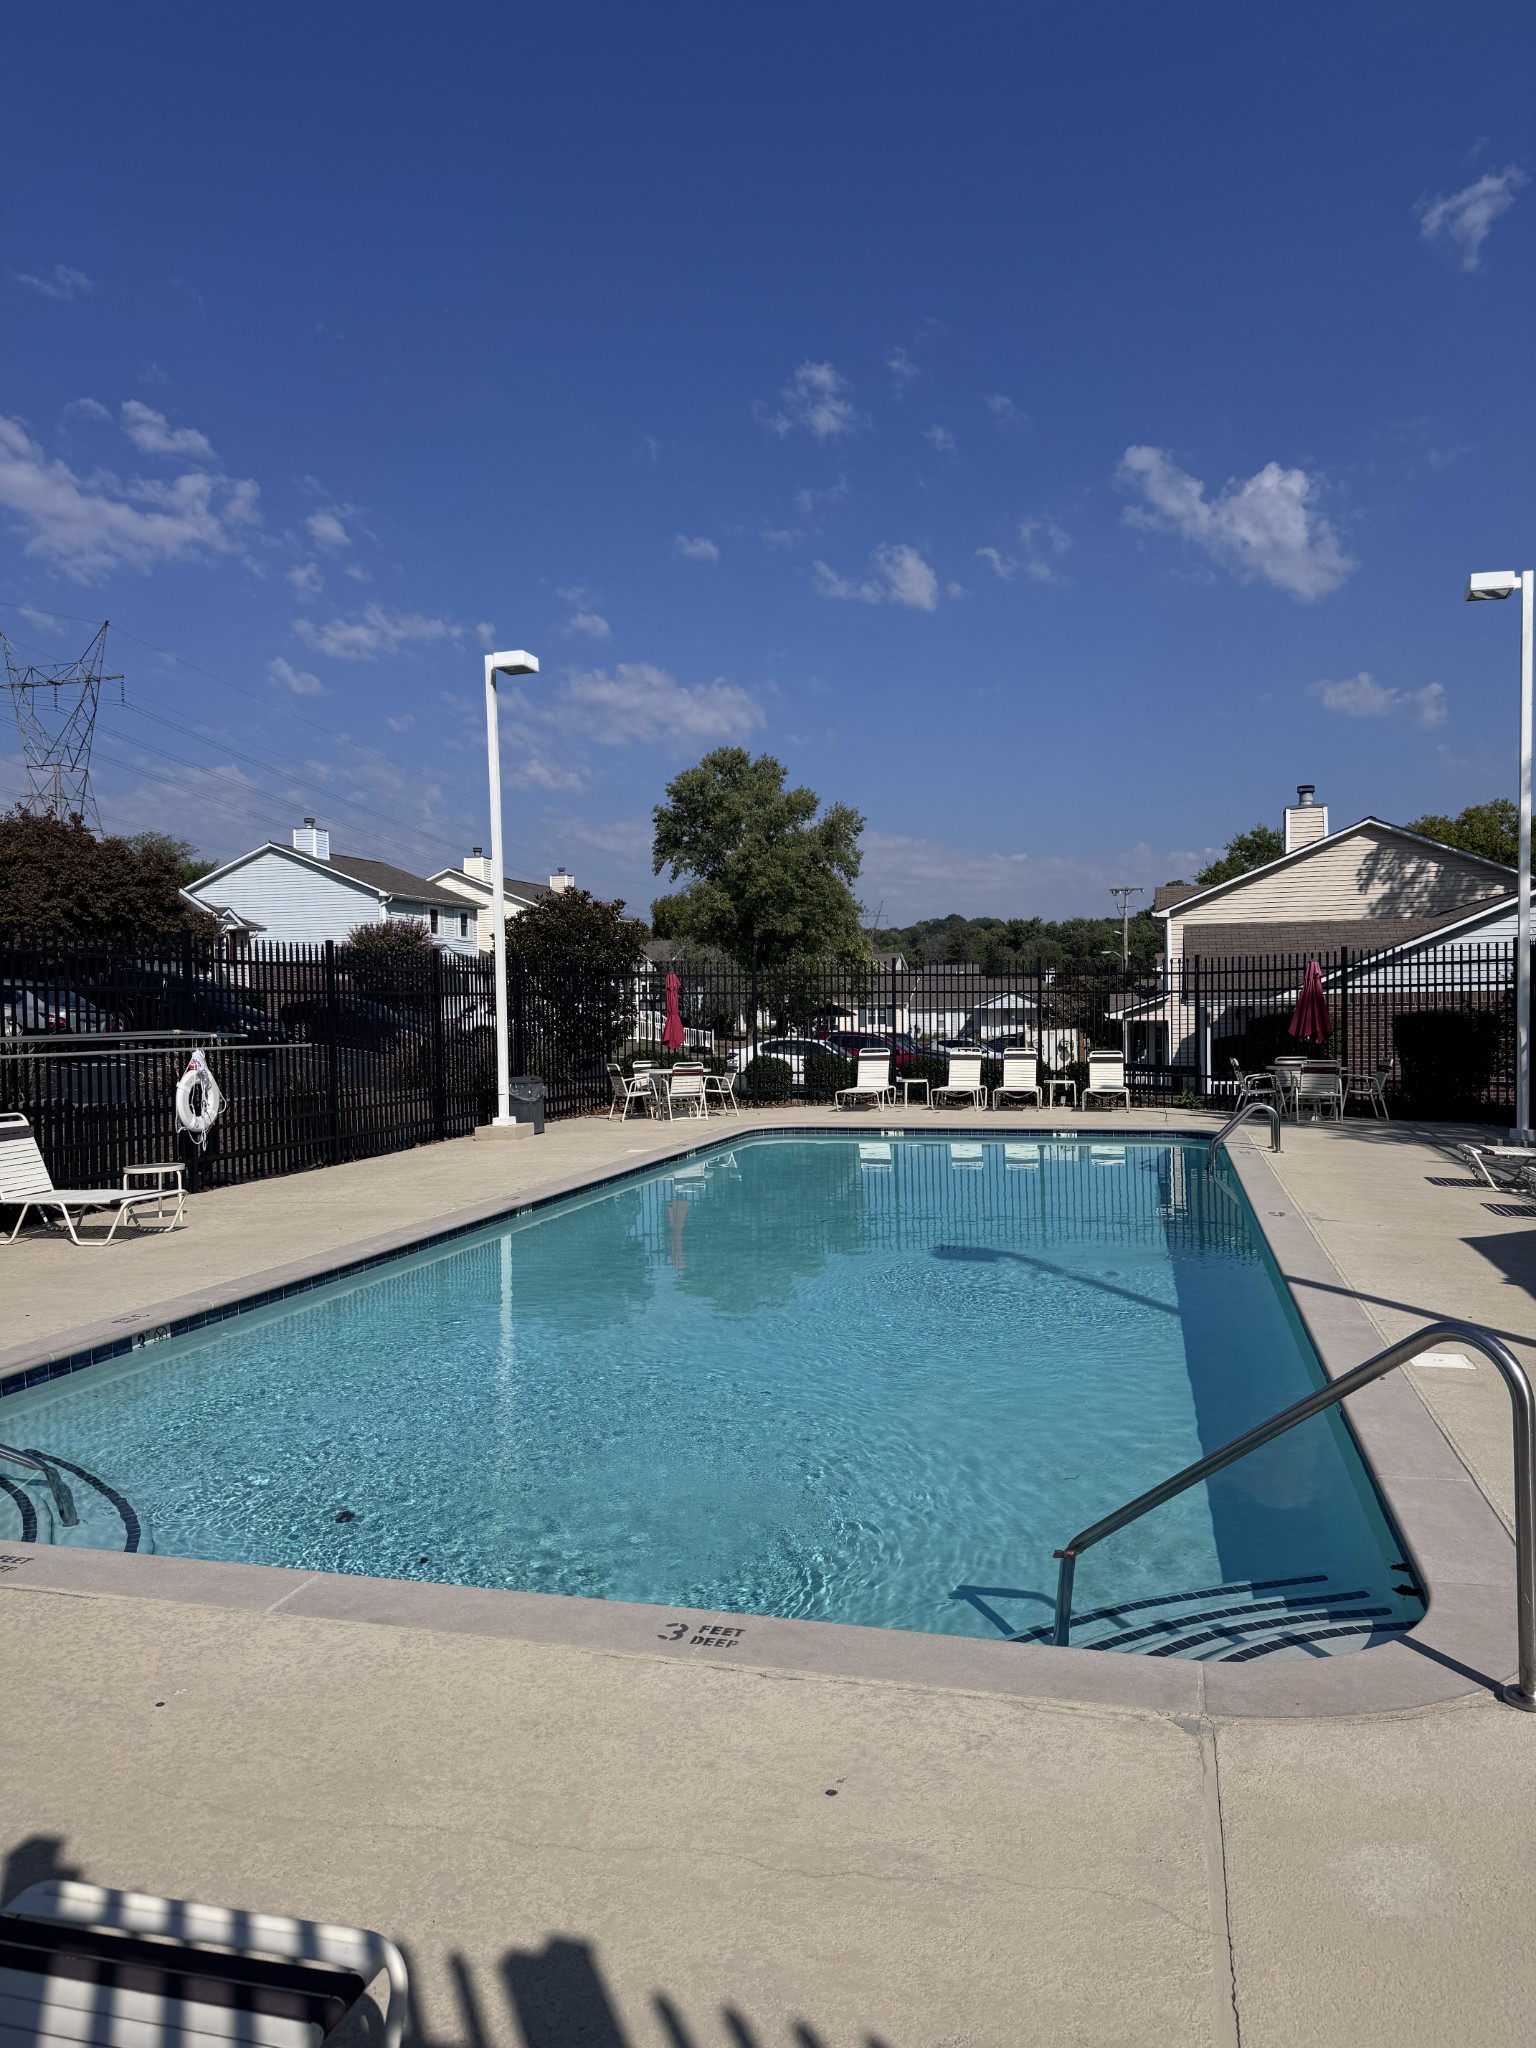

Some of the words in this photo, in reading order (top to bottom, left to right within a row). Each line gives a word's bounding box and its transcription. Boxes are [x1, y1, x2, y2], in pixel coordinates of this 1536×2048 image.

[657, 1622, 689, 1641] 3
[698, 1625, 746, 1638] FEET
[689, 1635, 740, 1649] DEEP
